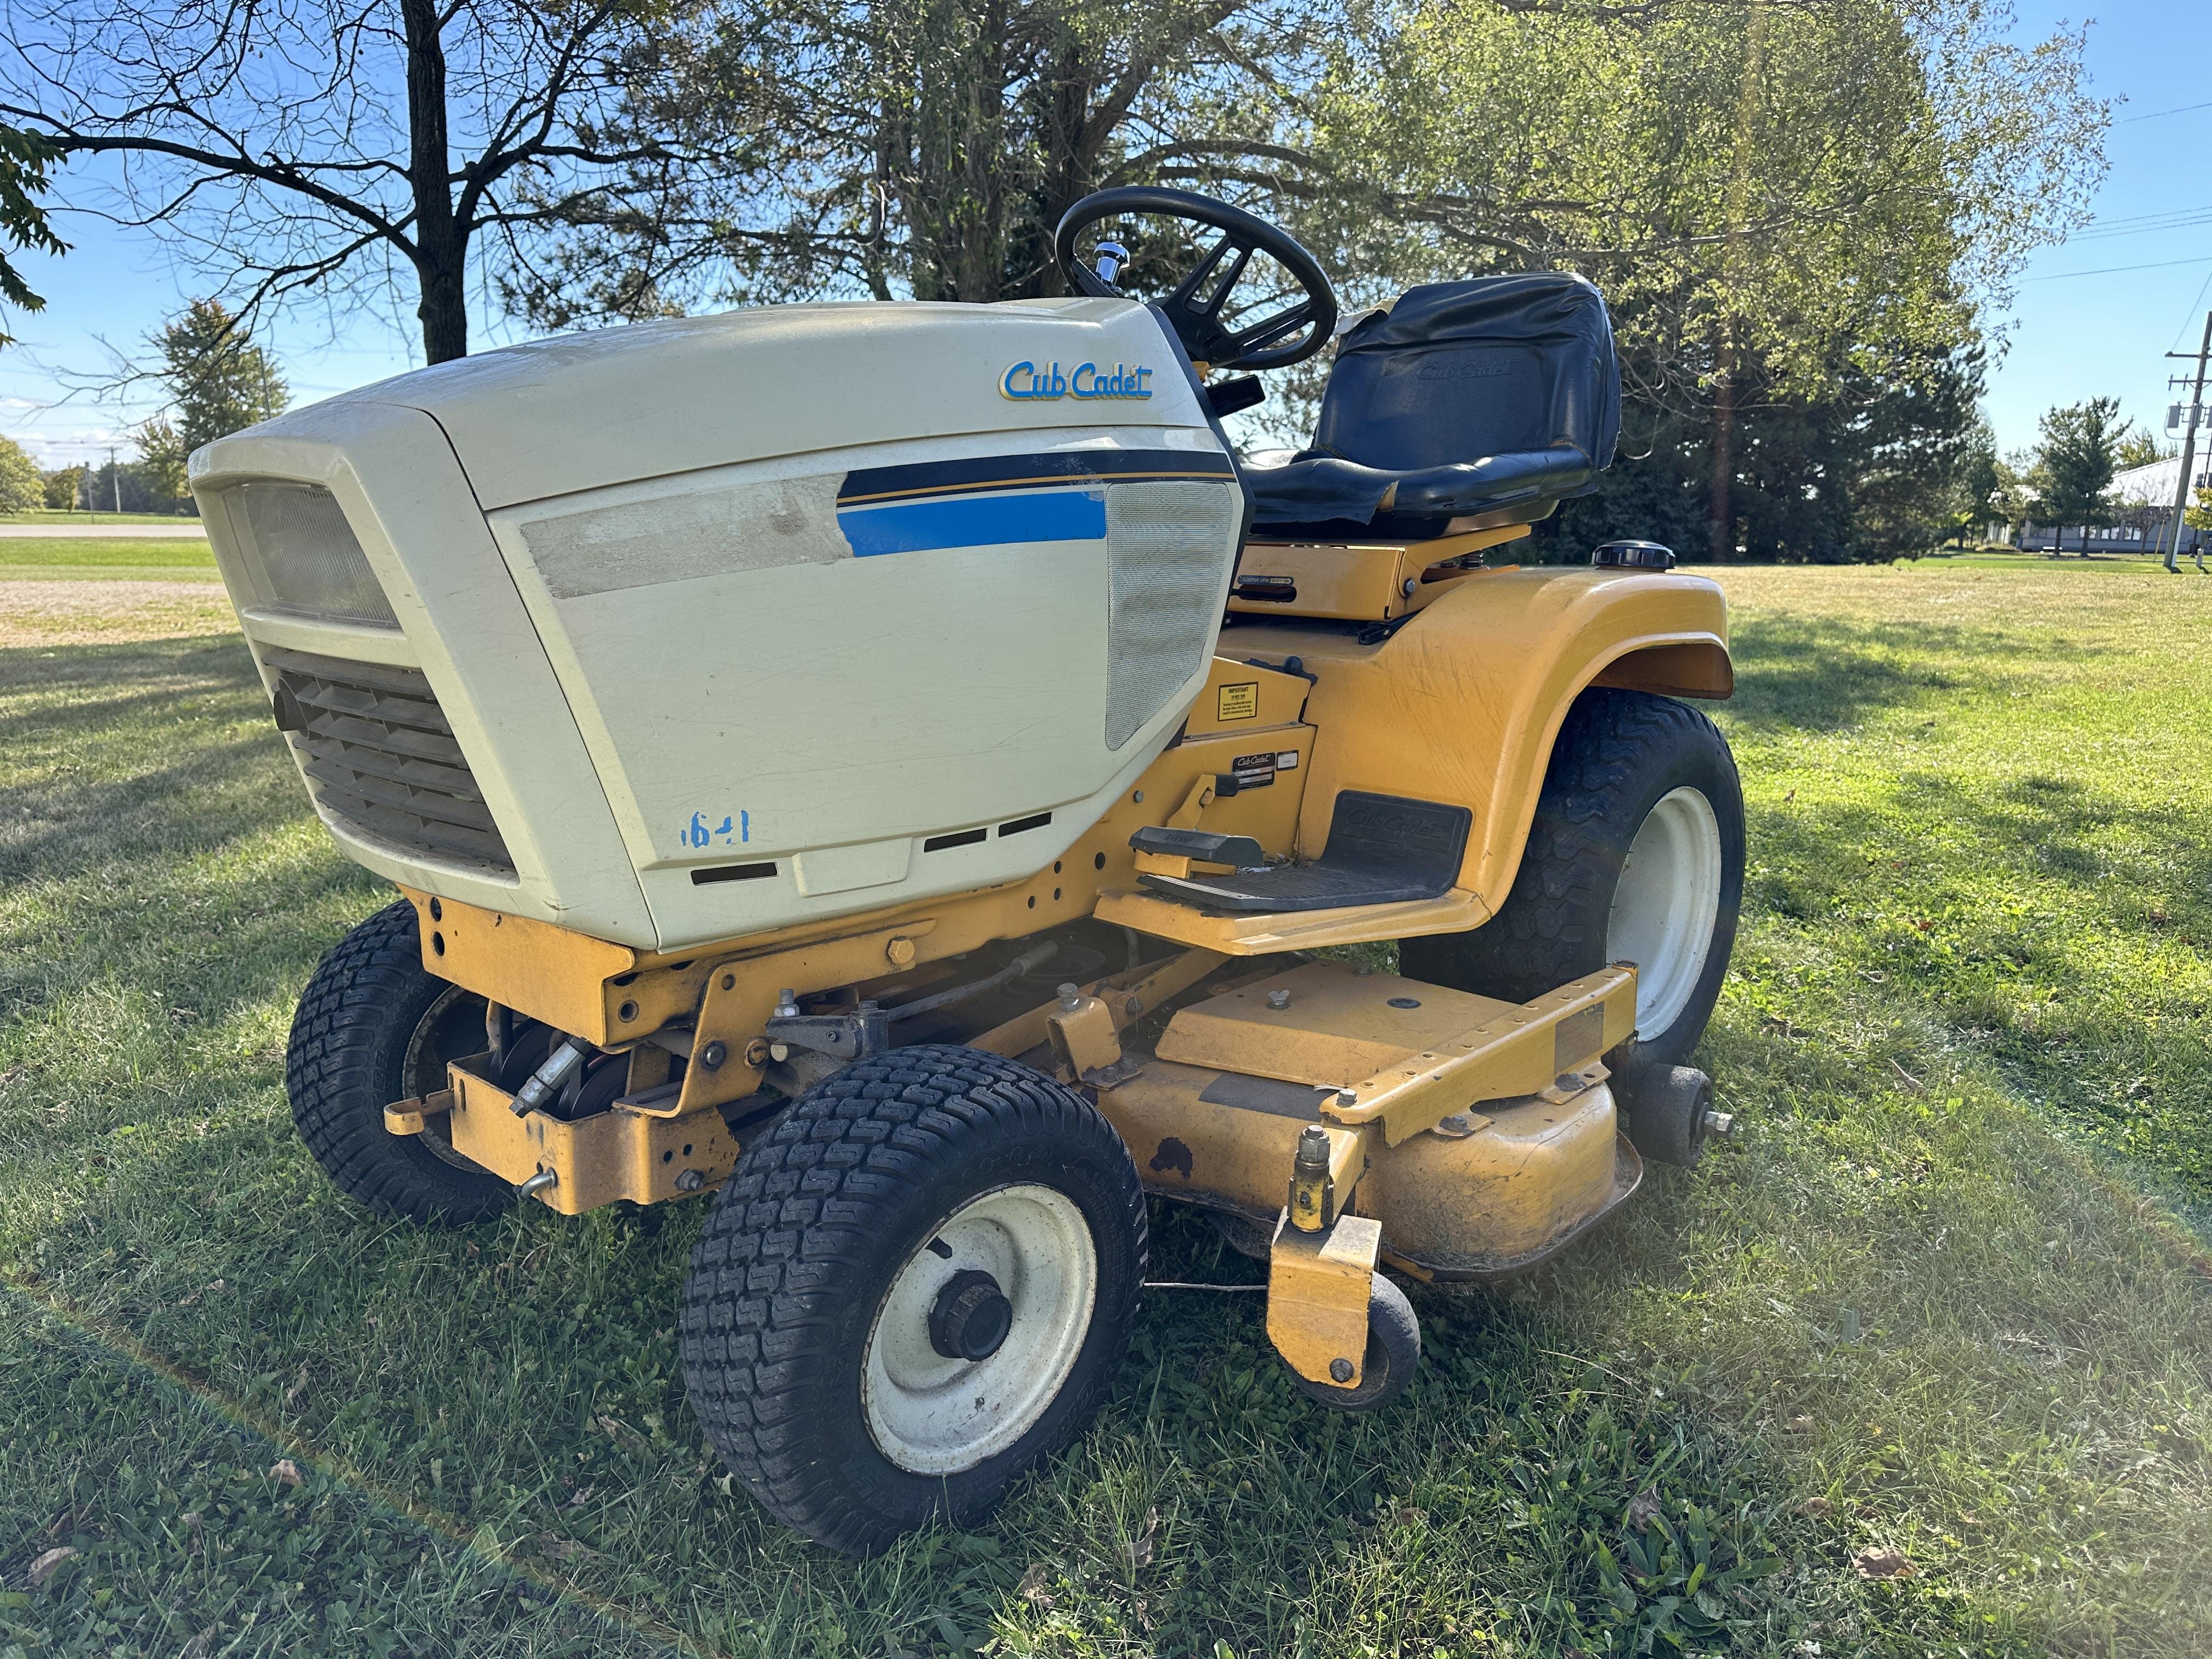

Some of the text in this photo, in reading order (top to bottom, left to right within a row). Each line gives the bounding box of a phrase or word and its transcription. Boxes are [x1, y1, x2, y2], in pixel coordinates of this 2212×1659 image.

[1001, 360, 1153, 399] Cub Cadet
[1418, 358, 1519, 380] Cub Cadet
[1238, 757, 1250, 766] Cub
[1250, 754, 1271, 764] Cadet
